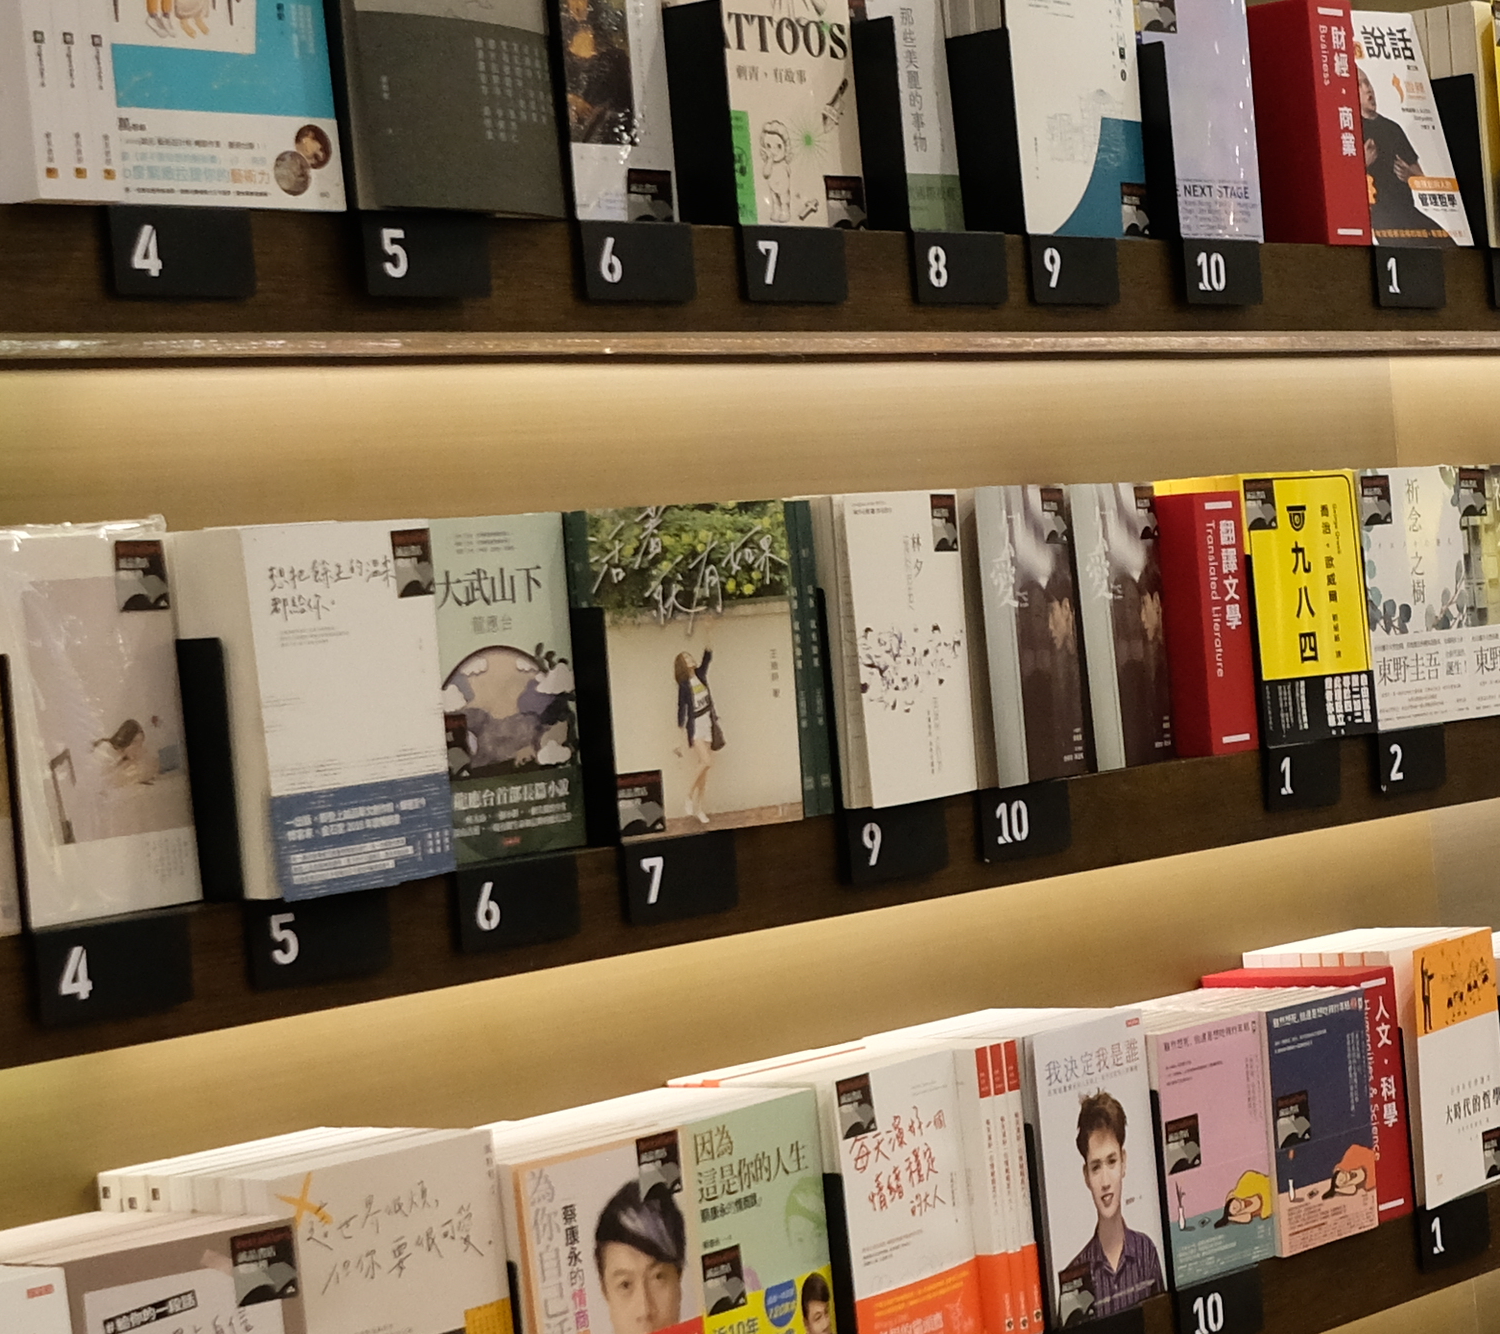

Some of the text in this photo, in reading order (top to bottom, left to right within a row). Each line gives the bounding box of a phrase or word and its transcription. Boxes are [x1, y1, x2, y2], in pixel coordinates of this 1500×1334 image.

[1318, 24, 1331, 87] Business
[1360, 25, 1416, 63] 說話
[899, 7, 929, 154] 那些美麗的事物
[132, 225, 163, 278] 4
[381, 228, 409, 279] 5
[601, 237, 622, 284] 6
[757, 239, 779, 286] 7
[927, 245, 949, 289] 8
[1043, 246, 1062, 289] 9
[1198, 252, 1226, 293] 10
[1387, 256, 1401, 294] 1
[1405, 476, 1426, 606] 祈念之樹
[435, 565, 543, 609] 大武山下
[1219, 518, 1244, 631] 翻譯文學
[1205, 520, 1225, 679] Translated Literature
[1376, 651, 1442, 687] 東野圭吾
[1280, 755, 1295, 796] 1
[1389, 743, 1404, 781] 2
[862, 823, 882, 866] 9
[996, 799, 1029, 845] 10
[640, 856, 664, 904] 7
[476, 880, 501, 931] 6
[270, 912, 300, 966] 5
[59, 946, 93, 1002] 4
[1044, 1037, 1140, 1087] 我決定我是誰
[693, 1123, 734, 1165] 因為
[697, 1140, 809, 1205] 這是你的人生
[1431, 1215, 1445, 1256] 1
